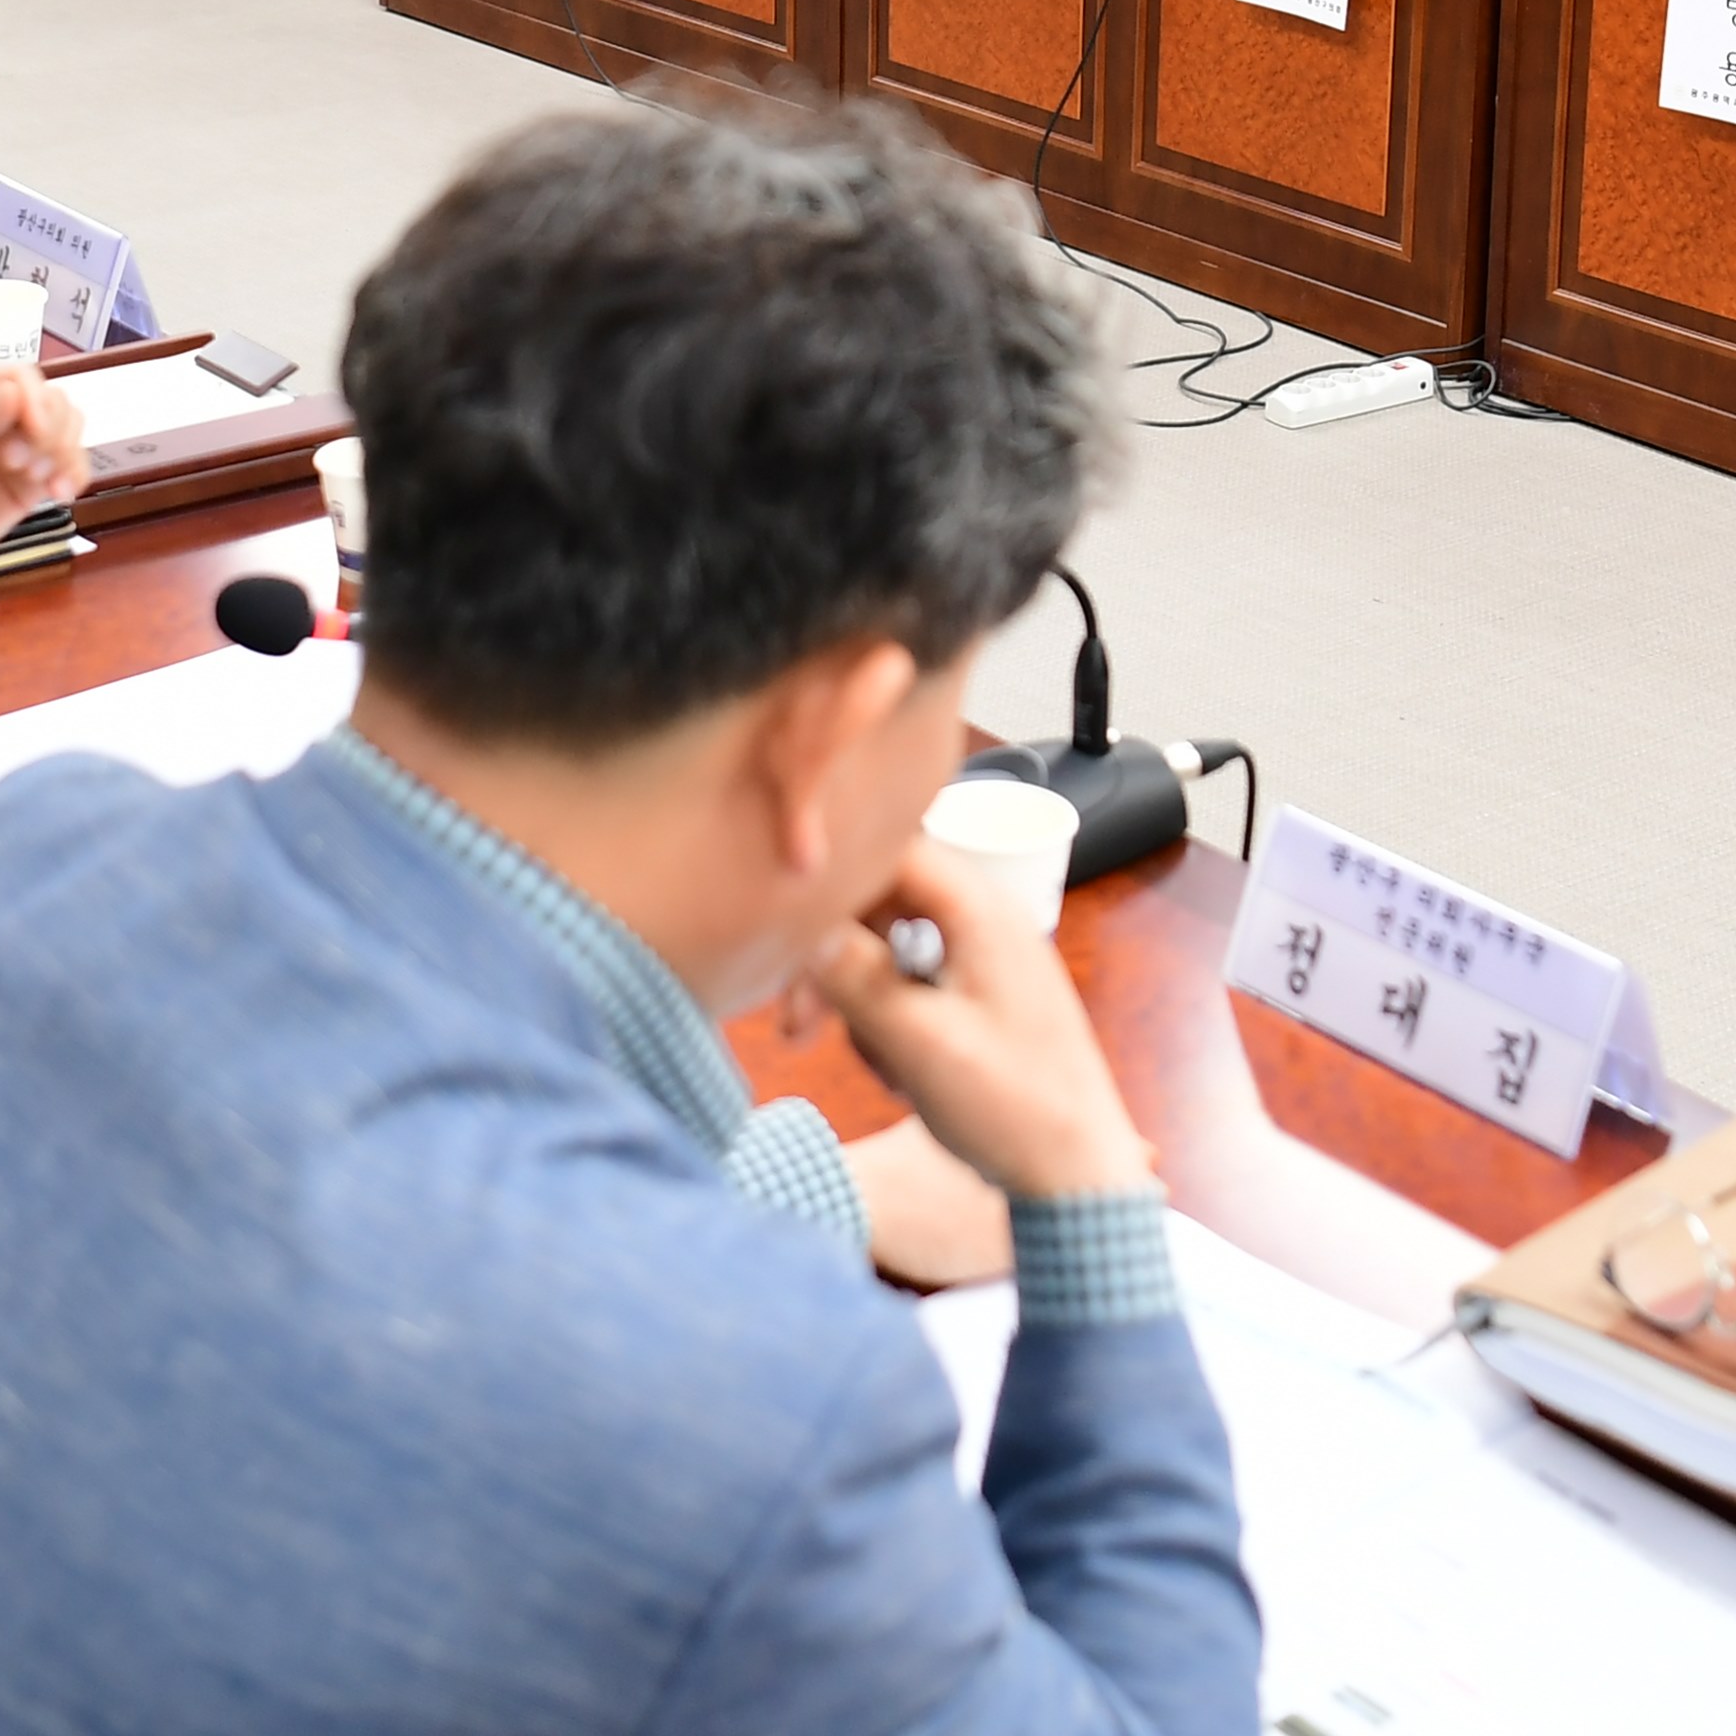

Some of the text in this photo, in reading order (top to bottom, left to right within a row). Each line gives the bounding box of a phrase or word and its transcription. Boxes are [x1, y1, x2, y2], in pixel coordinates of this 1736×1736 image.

[17, 208, 93, 260] 광산구의회 의원
[1330, 842, 1401, 894] 광산구
[1276, 922, 1540, 1106] 정대집
